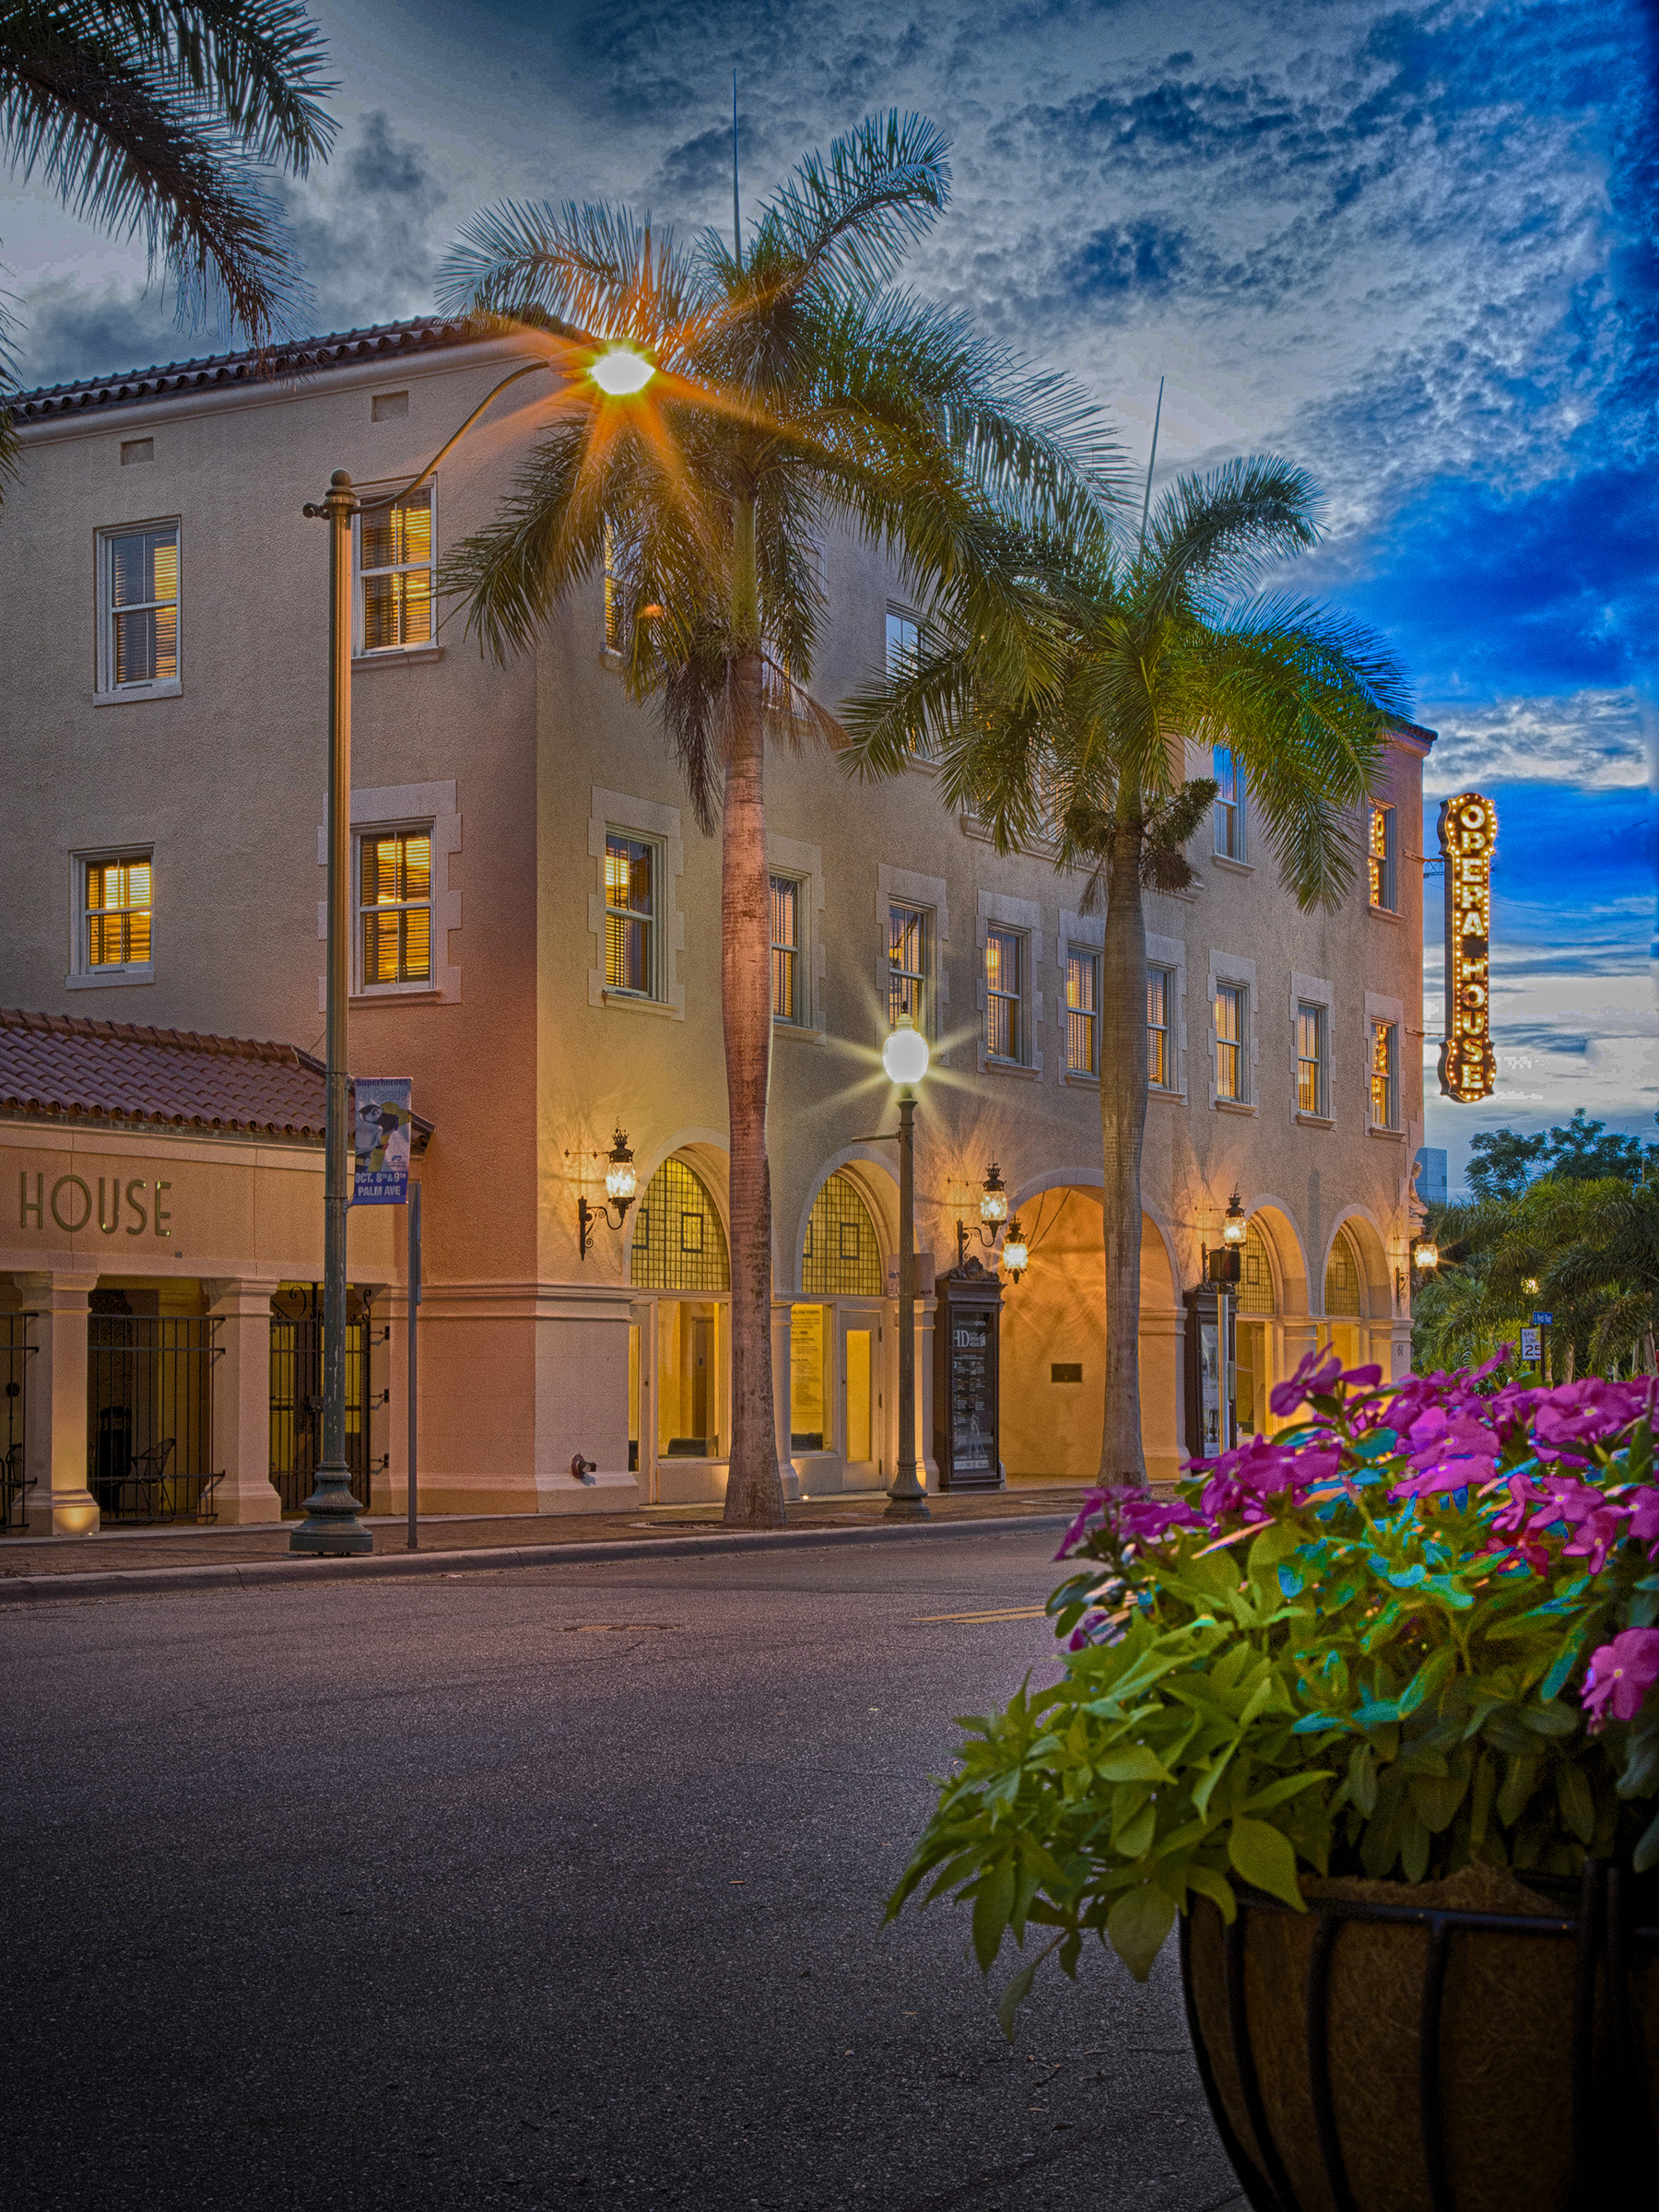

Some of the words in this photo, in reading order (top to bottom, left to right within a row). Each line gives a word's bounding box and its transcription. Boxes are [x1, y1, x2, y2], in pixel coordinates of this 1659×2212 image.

[1460, 804, 1486, 935] OPERA
[1461, 958, 1486, 1088] HOUSE
[356, 1078, 408, 1087] Superheroes
[359, 1090, 371, 1101] on
[373, 1088, 406, 1101] Parade
[358, 1185, 382, 1196] PALM
[383, 1185, 401, 1196] AVE
[20, 1171, 171, 1236] HOUSE
[1525, 1345, 1541, 1357] 25
